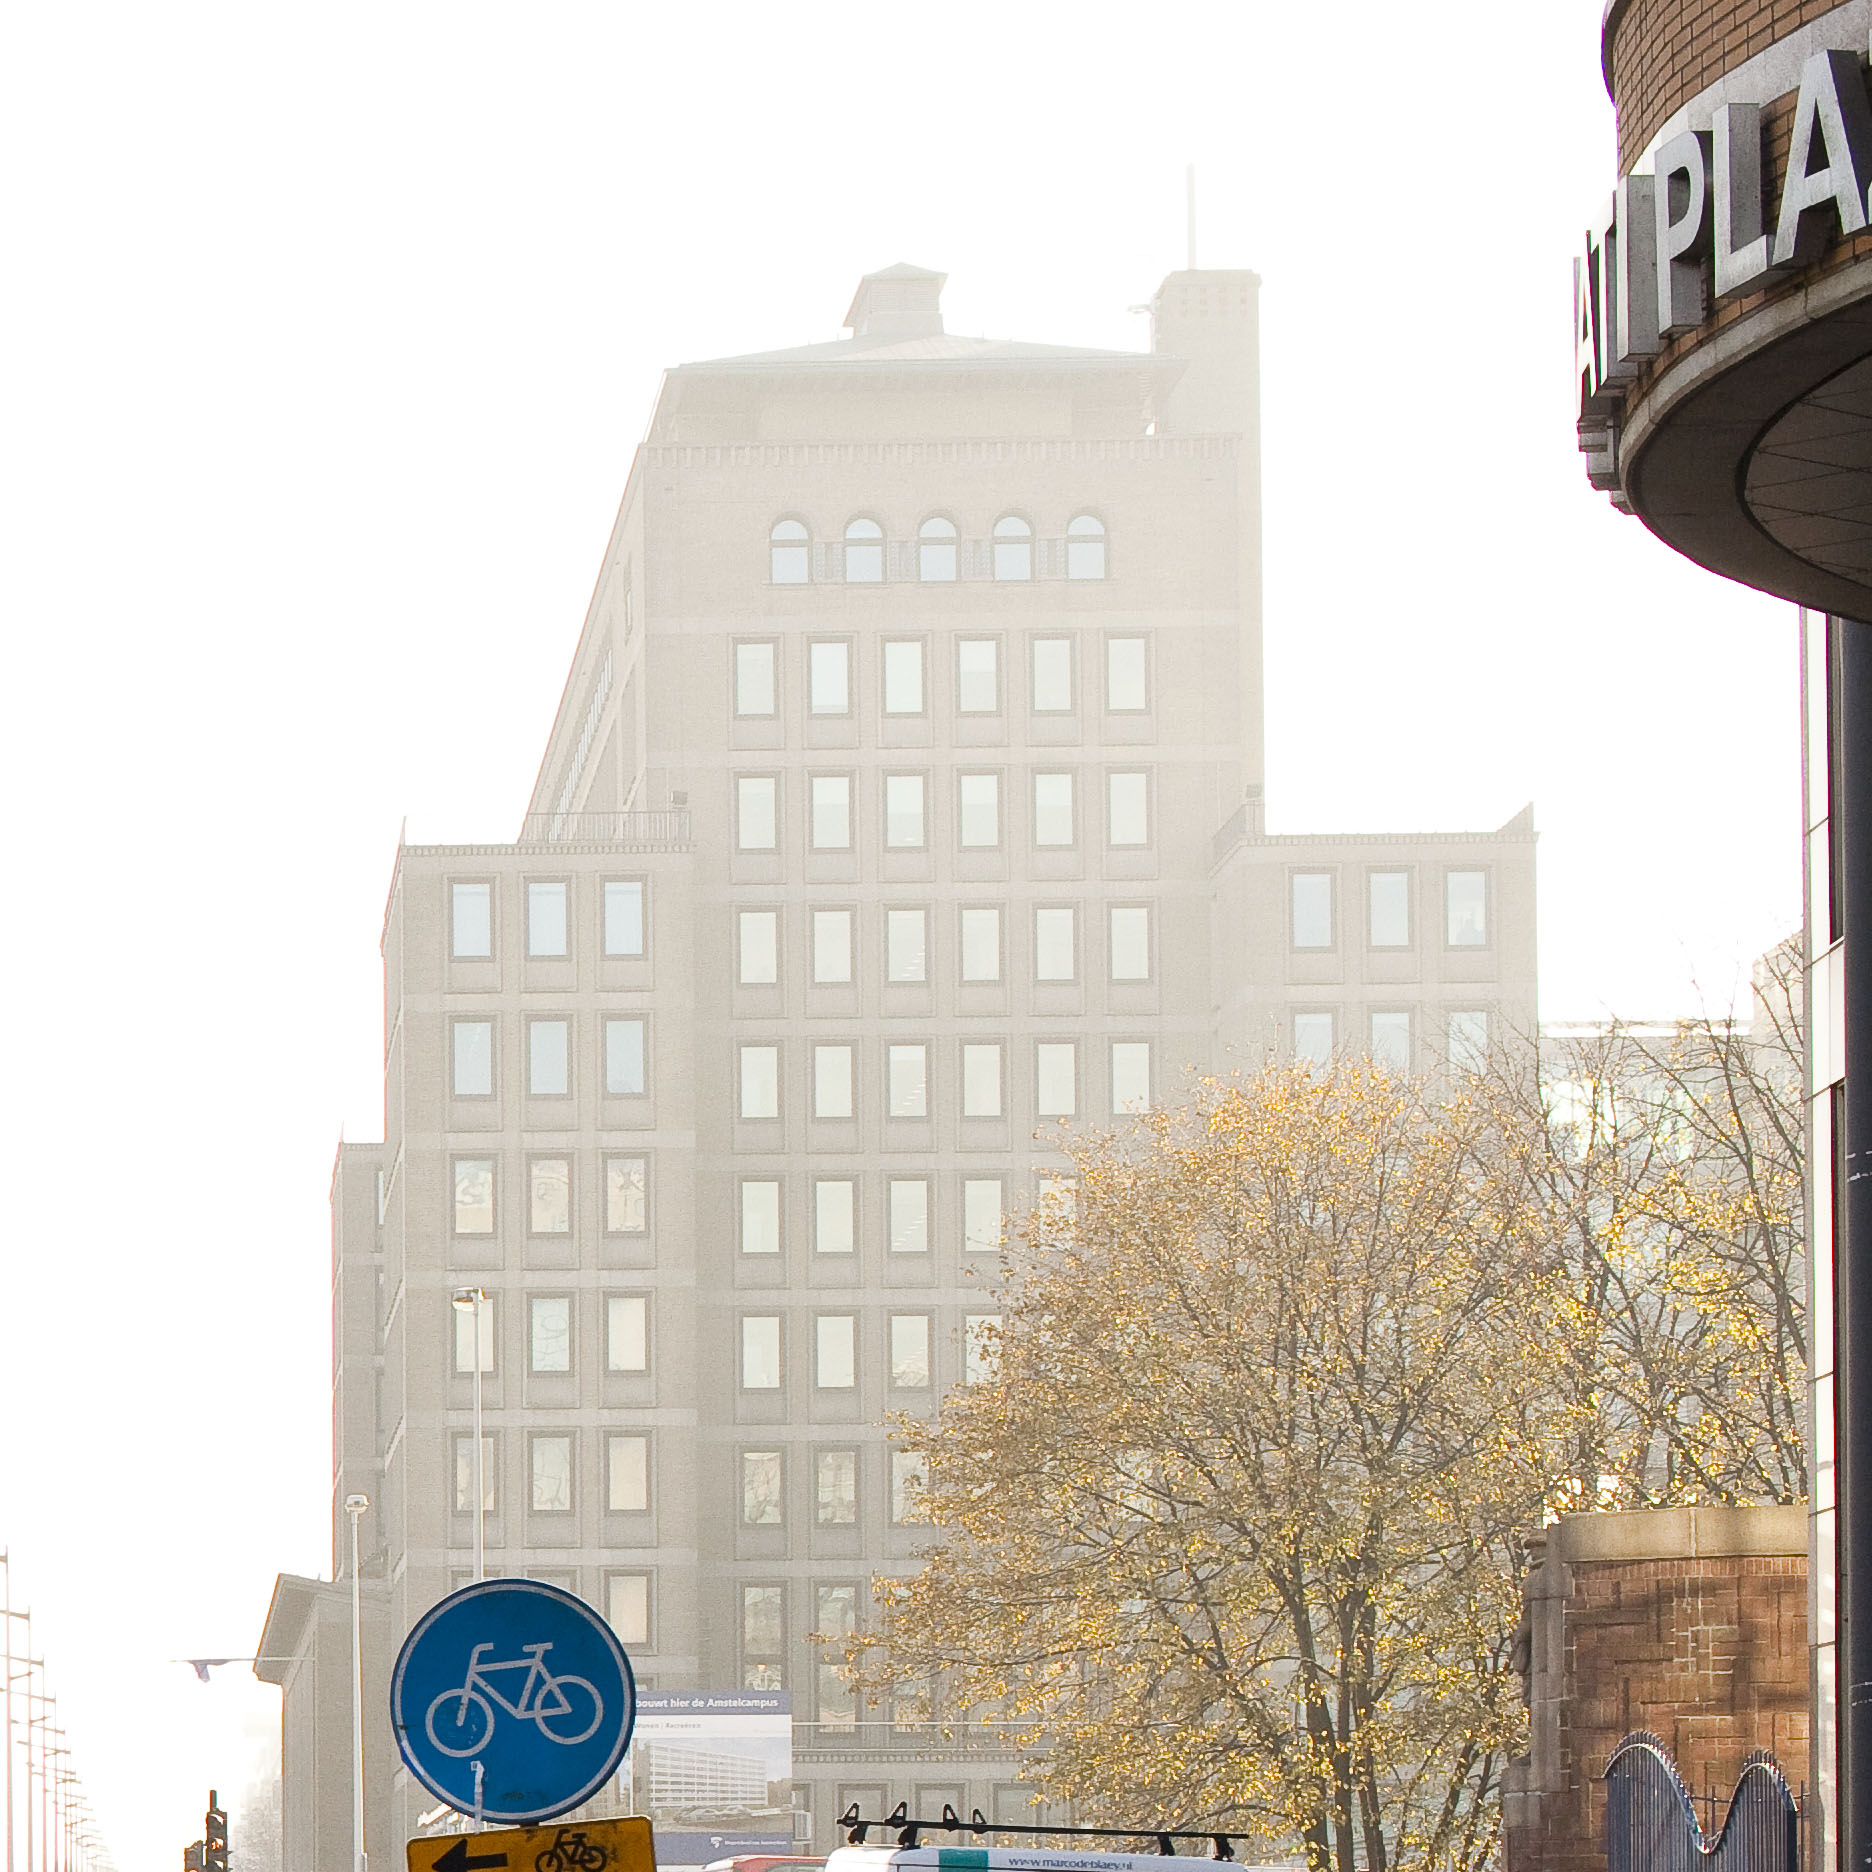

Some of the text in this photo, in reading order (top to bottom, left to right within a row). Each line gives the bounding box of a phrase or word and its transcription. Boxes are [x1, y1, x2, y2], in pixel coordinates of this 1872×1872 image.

[1655, 28, 1872, 337] PLA
[692, 1698, 705, 1708] de
[706, 1698, 779, 1709] Amstelcampus
